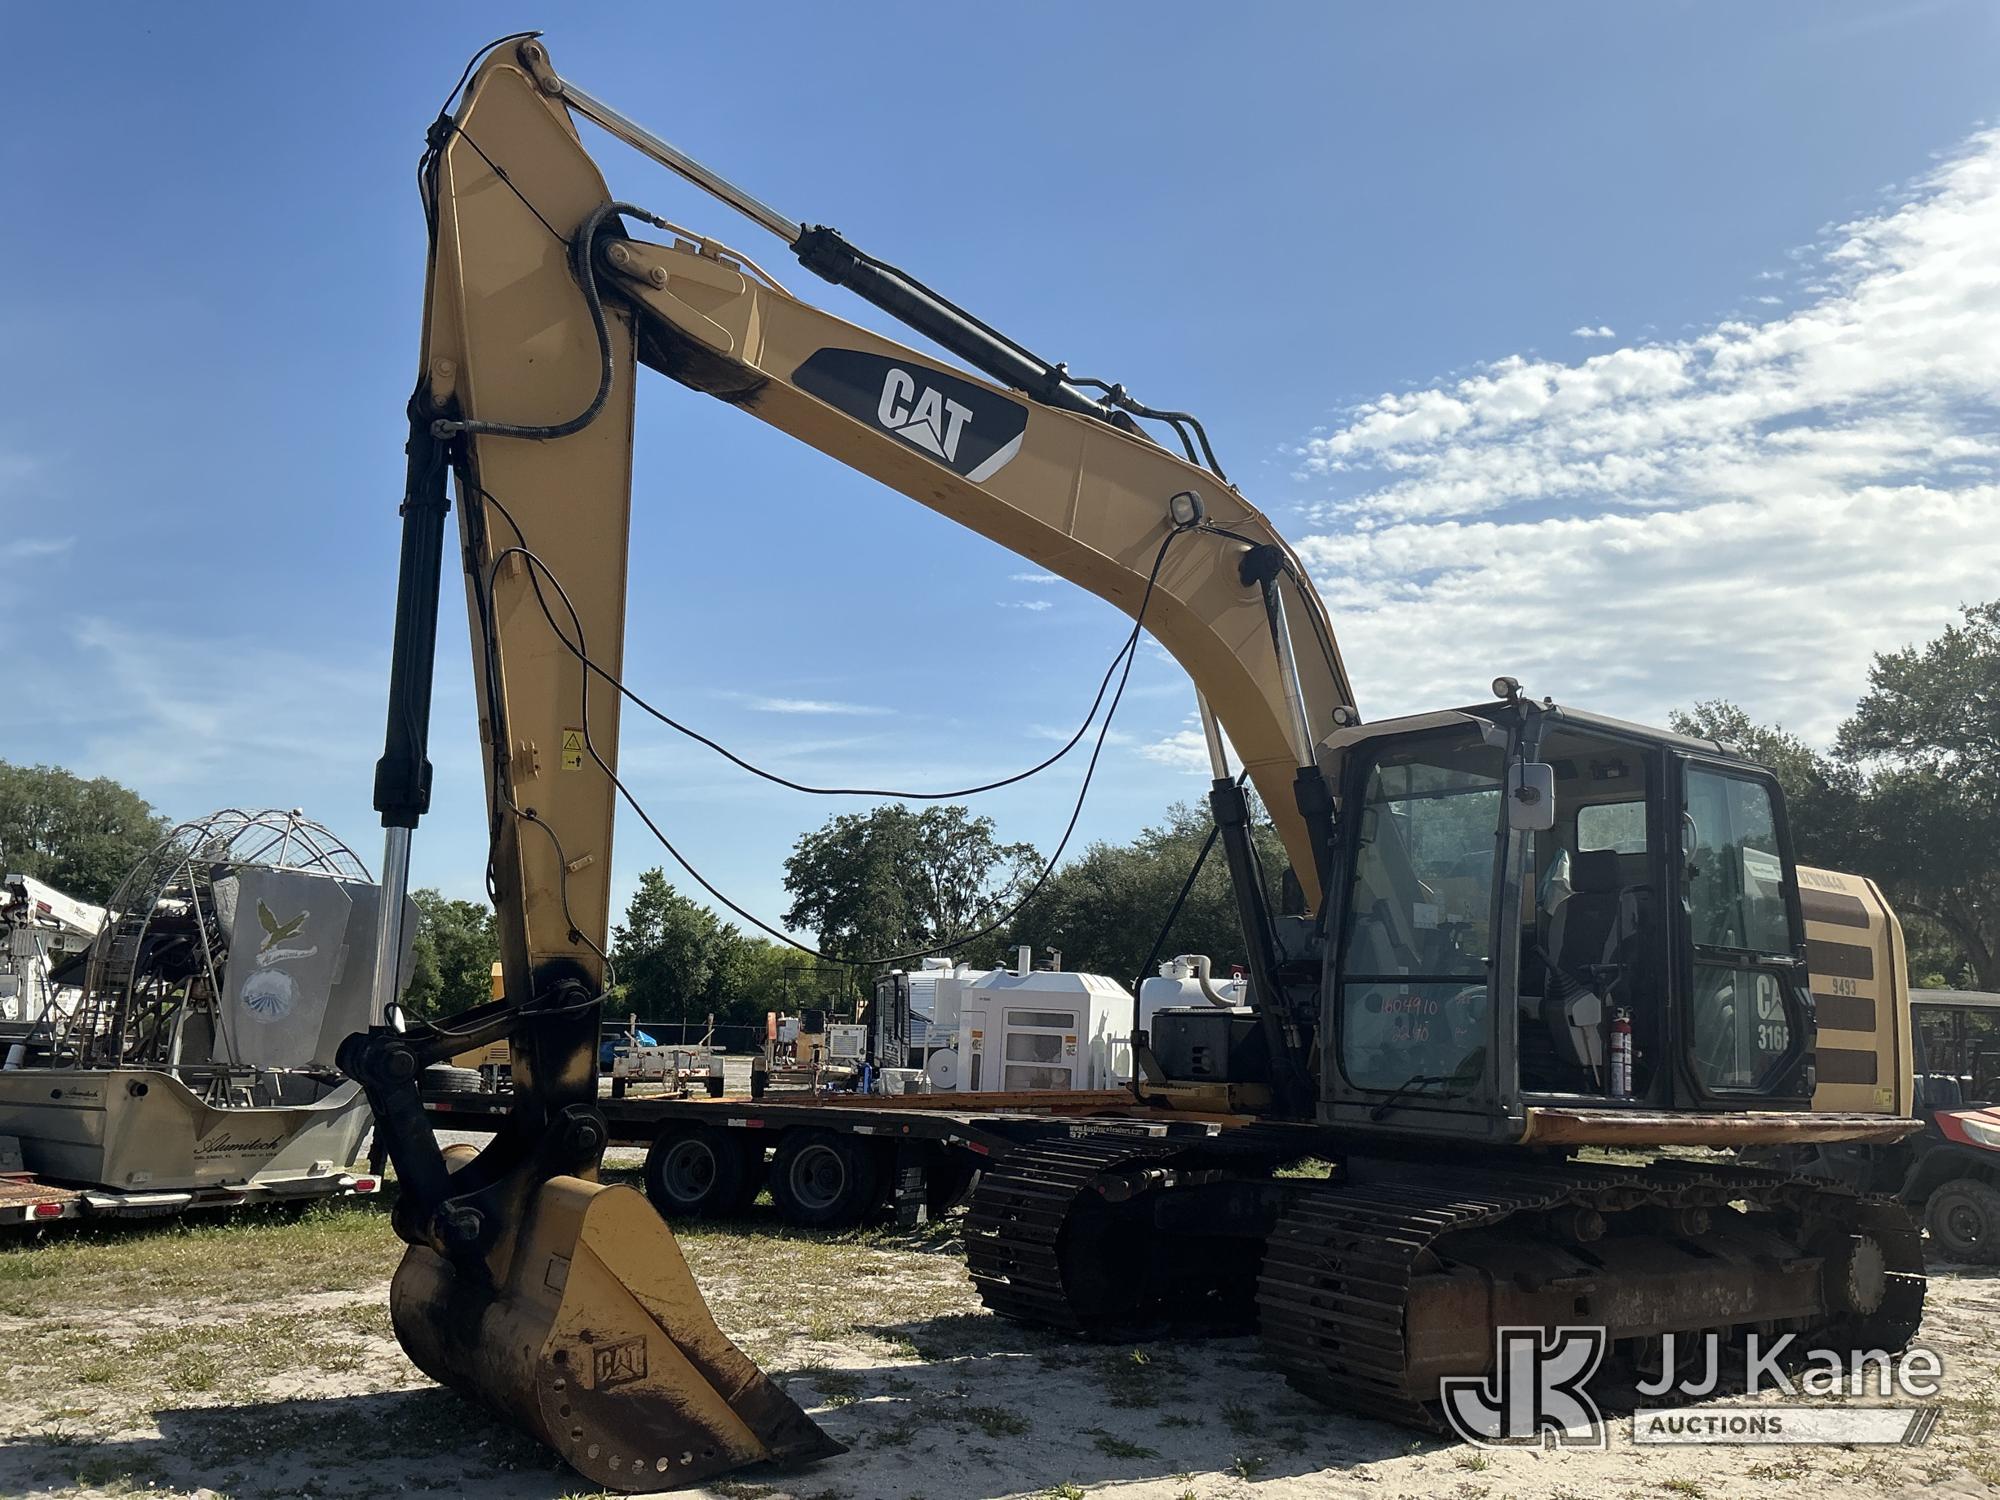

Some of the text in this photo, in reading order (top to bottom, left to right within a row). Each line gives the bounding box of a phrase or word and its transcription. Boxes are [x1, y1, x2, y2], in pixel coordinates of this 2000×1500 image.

[878, 368, 973, 463] CAT
[1757, 975, 1786, 1021] CA
[1832, 978, 1857, 996] 9493
[597, 1343, 643, 1382] CAT
